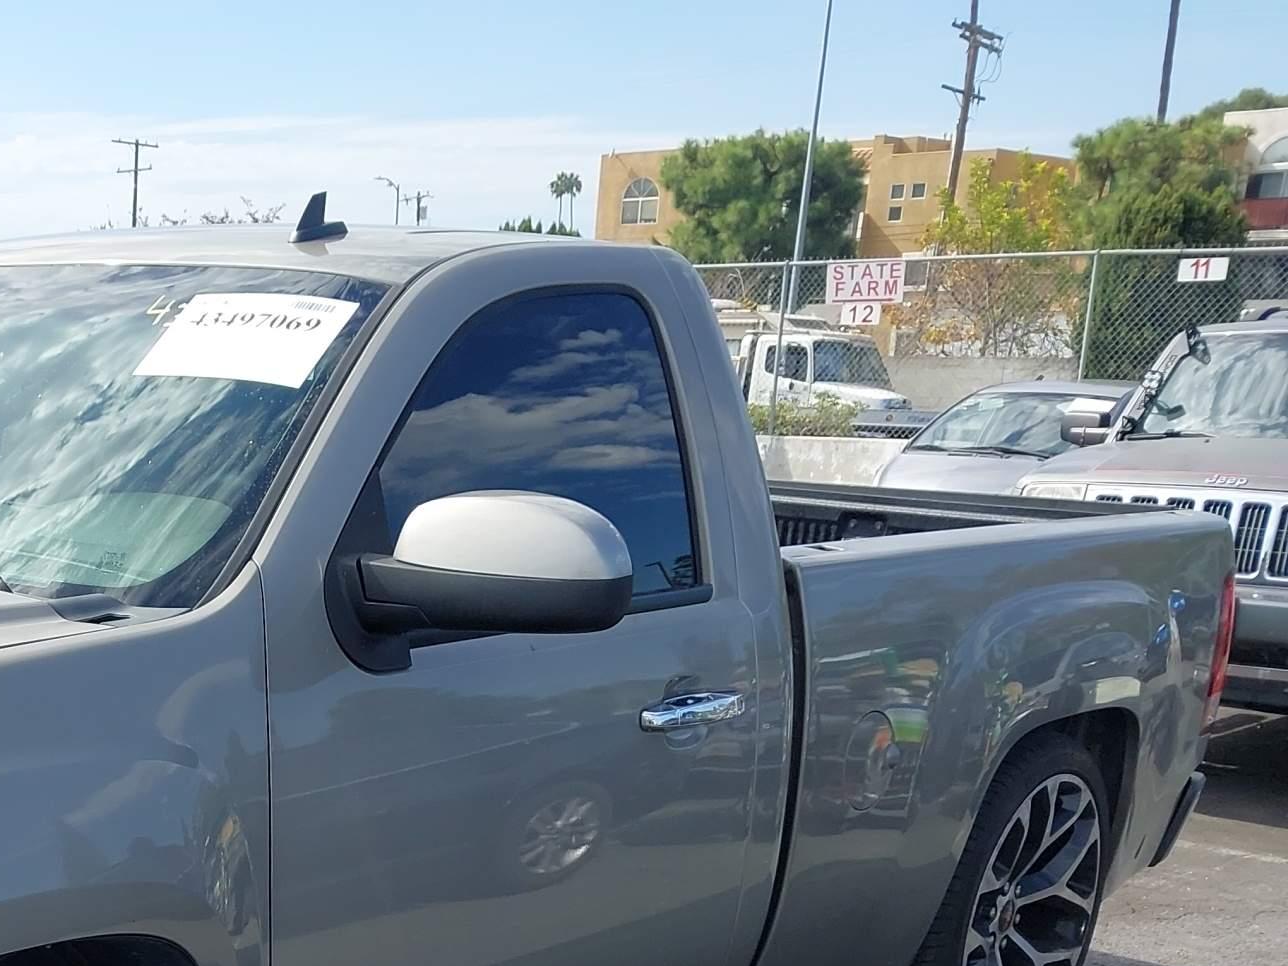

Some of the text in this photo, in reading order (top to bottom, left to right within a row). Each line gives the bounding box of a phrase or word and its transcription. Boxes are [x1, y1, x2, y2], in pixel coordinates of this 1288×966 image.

[833, 263, 902, 281] STATE
[1191, 258, 1211, 279] 11
[835, 279, 899, 297] FARM
[190, 311, 323, 333] 43497069
[849, 305, 874, 323] 12
[1205, 473, 1249, 488] Jeep
